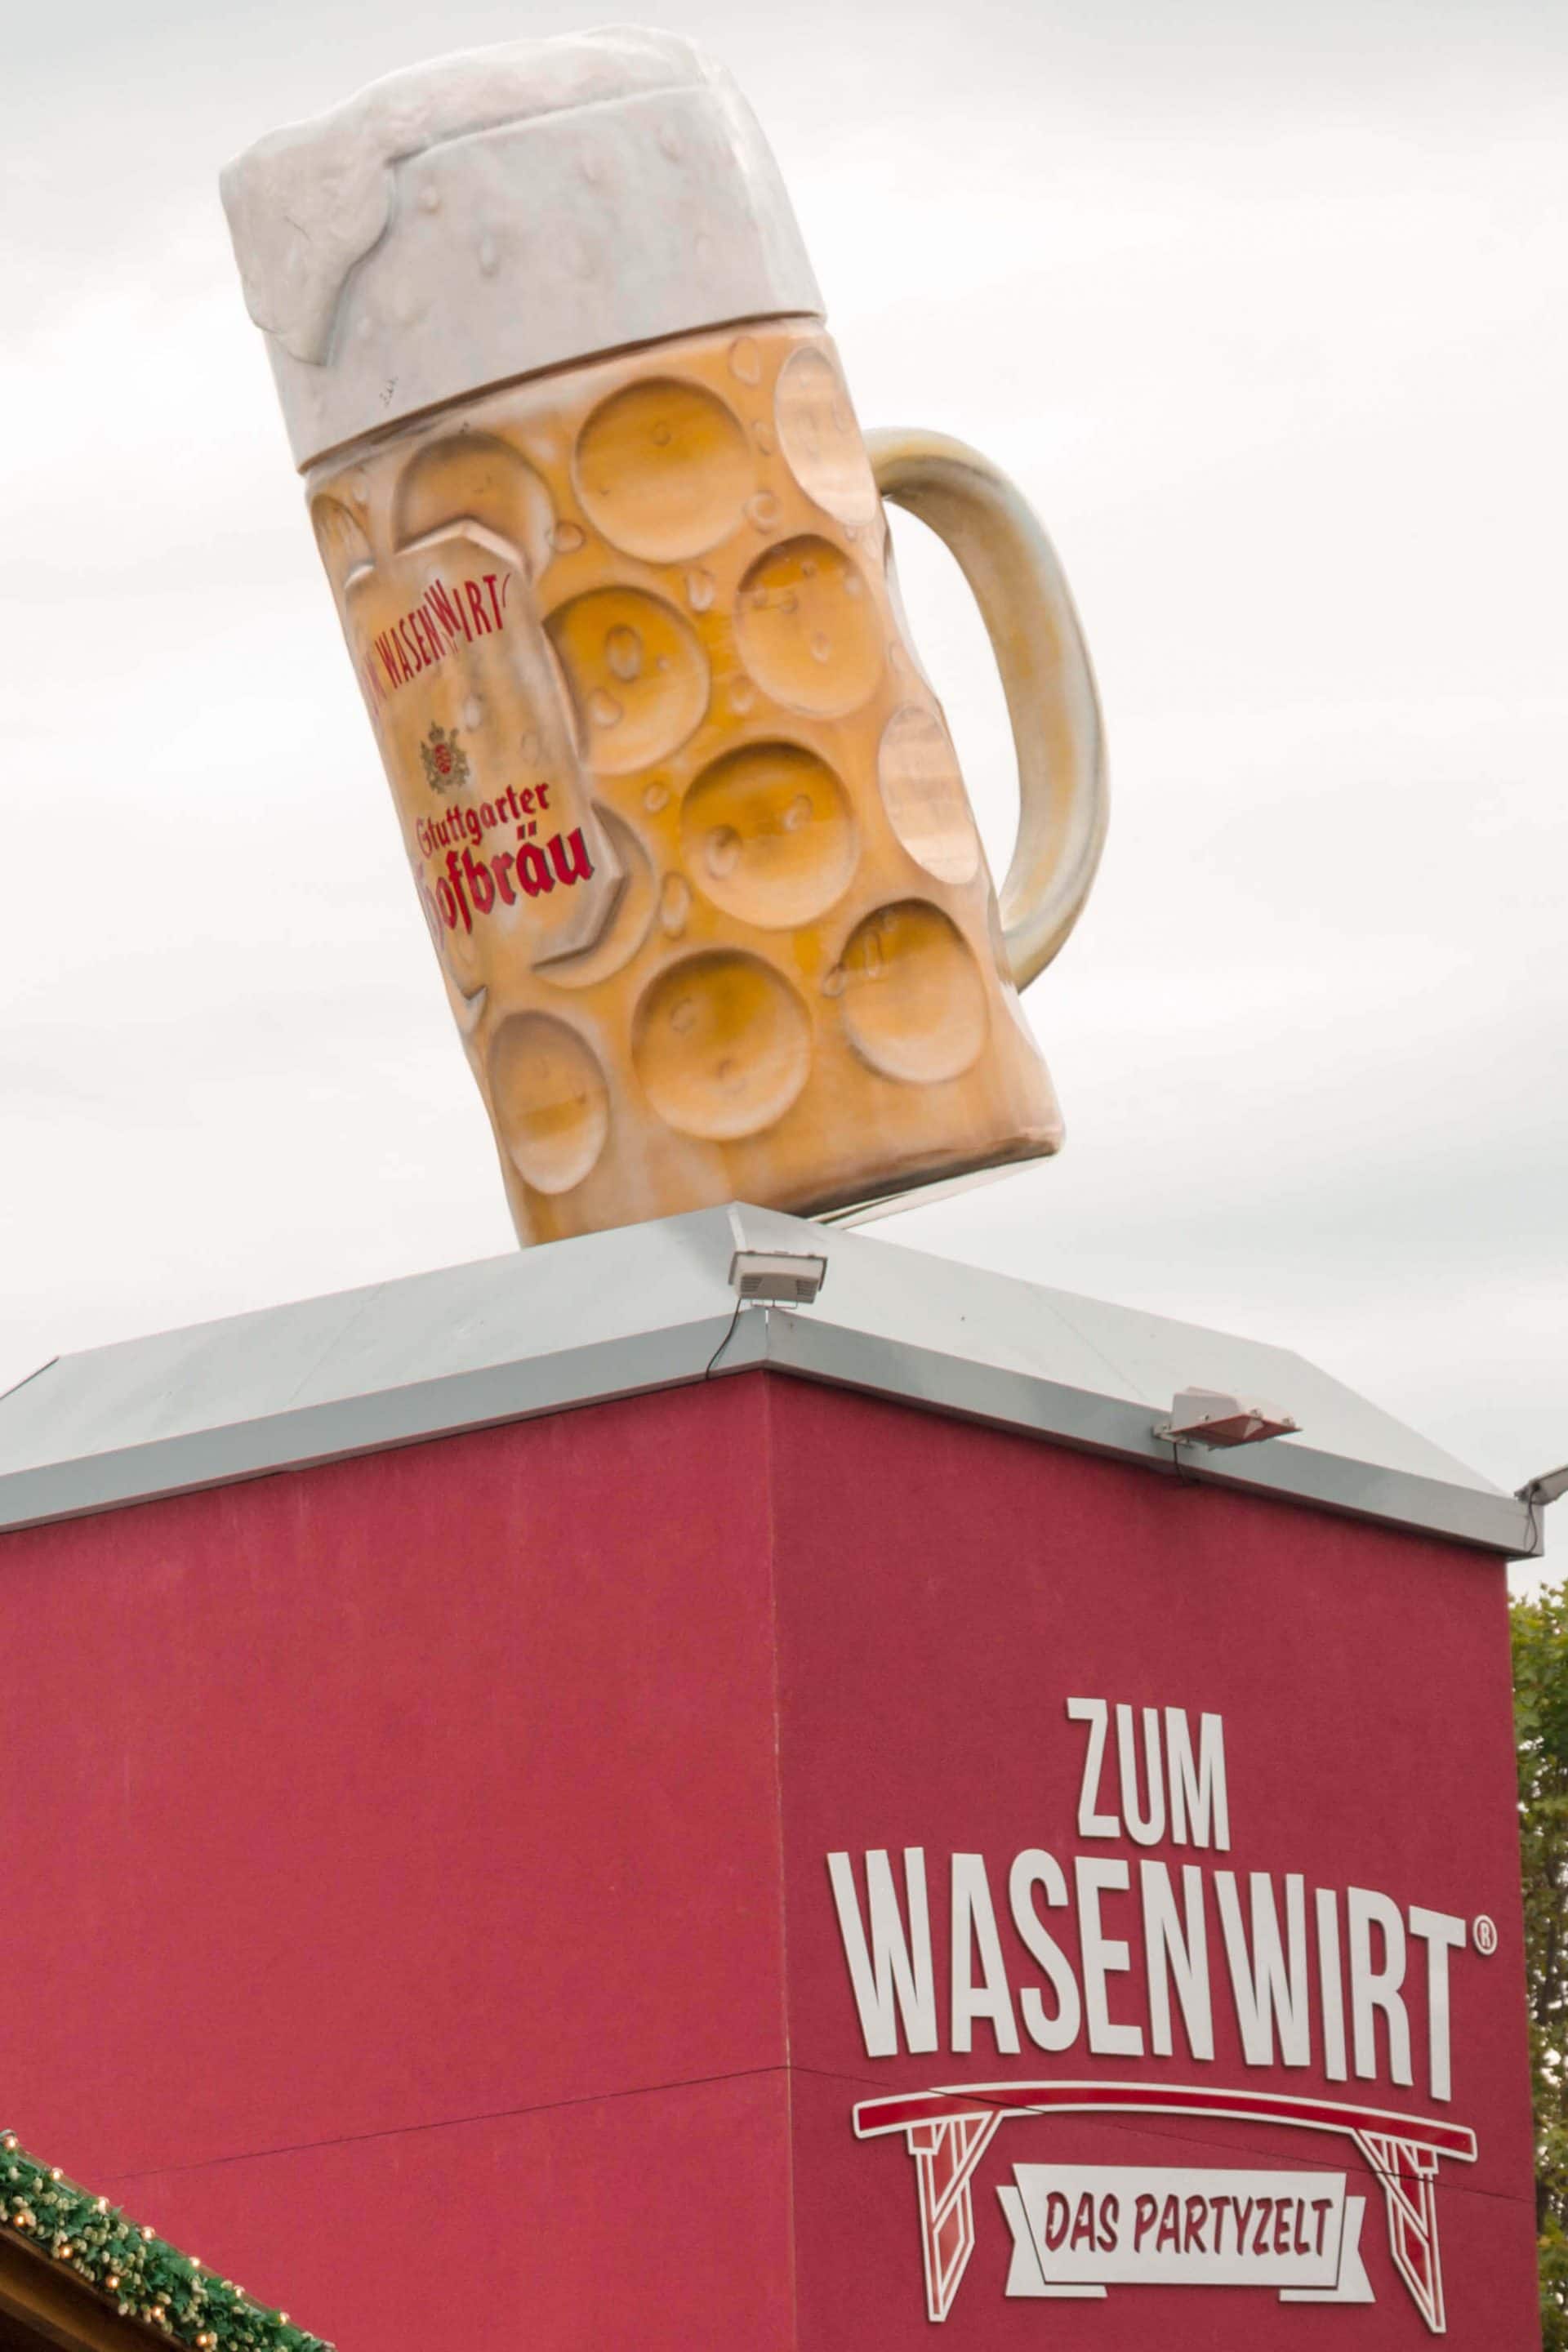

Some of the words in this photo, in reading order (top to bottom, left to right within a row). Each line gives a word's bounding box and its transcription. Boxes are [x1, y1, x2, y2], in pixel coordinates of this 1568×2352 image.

[375, 574, 503, 689] WASENWIRT
[416, 783, 550, 858] Stuttgarter
[1067, 1697, 1231, 1851] ZUM
[1045, 2191, 1119, 2252] DAS
[1134, 2193, 1334, 2256] PARTYZELT
